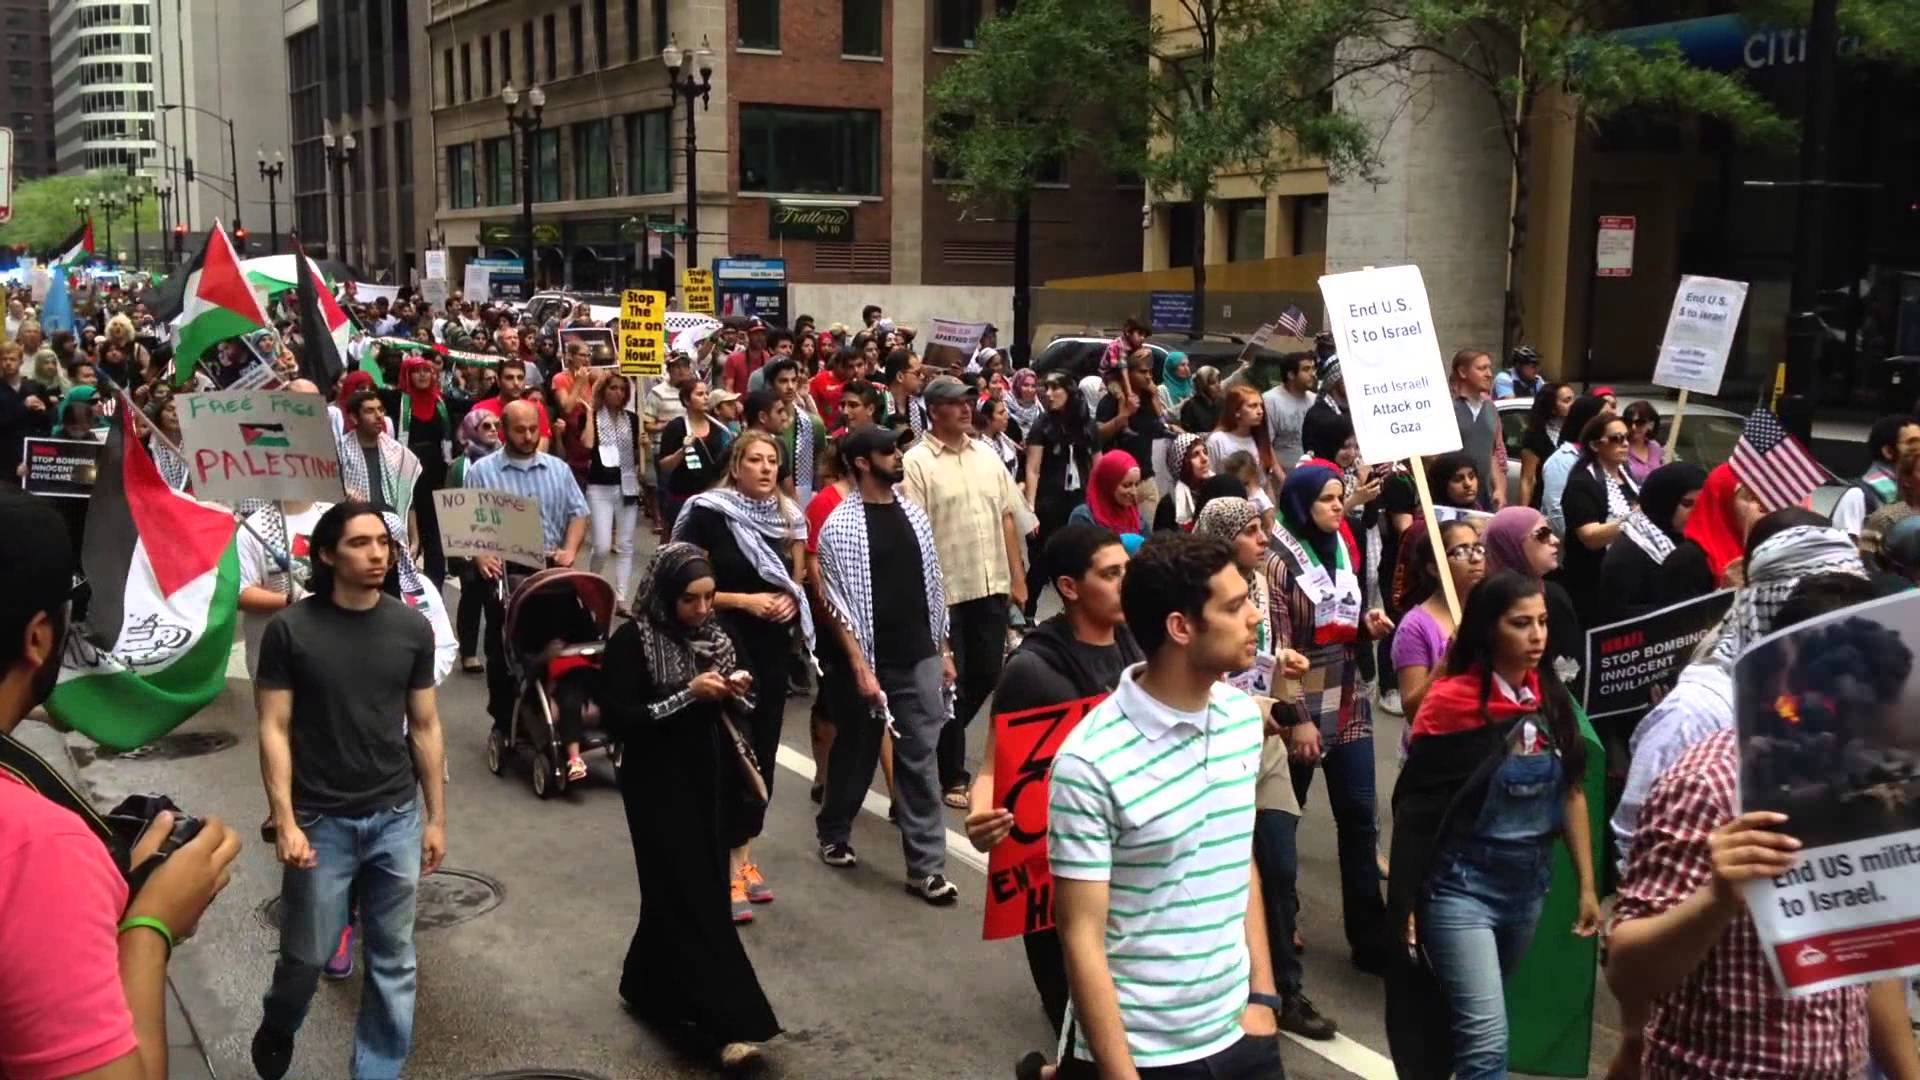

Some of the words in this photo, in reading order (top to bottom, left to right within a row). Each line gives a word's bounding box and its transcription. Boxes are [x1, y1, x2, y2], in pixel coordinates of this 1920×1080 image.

[777, 206, 847, 224] Trattoria
[831, 225, 840, 234] 10
[688, 269, 707, 278] Stop
[627, 291, 655, 306] Stop
[1685, 292, 1705, 304] End
[629, 305, 651, 317] The
[1349, 301, 1377, 318] End
[1381, 298, 1412, 313] U.S.
[1687, 309, 1697, 317] to
[620, 319, 641, 330] War
[644, 321, 662, 331] on
[1351, 329, 1359, 344] $
[1363, 329, 1378, 343] to
[1382, 321, 1422, 340] Israel
[626, 335, 655, 348] Gaza
[625, 349, 656, 361] Now!
[1363, 382, 1388, 396] End
[1392, 375, 1430, 392] Israeli
[1373, 400, 1412, 417] Attack
[1415, 399, 1431, 410] on
[1390, 421, 1422, 435] Gaza
[31, 464, 73, 473] INNOCENT
[31, 472, 72, 481] CIVILIANS
[442, 494, 466, 508] NO
[1601, 650, 1640, 668] STOP
[1643, 629, 1709, 658] BOMBING
[1601, 654, 1675, 682] INNOCENT
[1600, 670, 1669, 695] CIVILIANS
[1819, 854, 1853, 878] US
[1860, 843, 1920, 872] milit
[1779, 897, 1805, 918] to
[1809, 880, 1887, 912] Israel.
